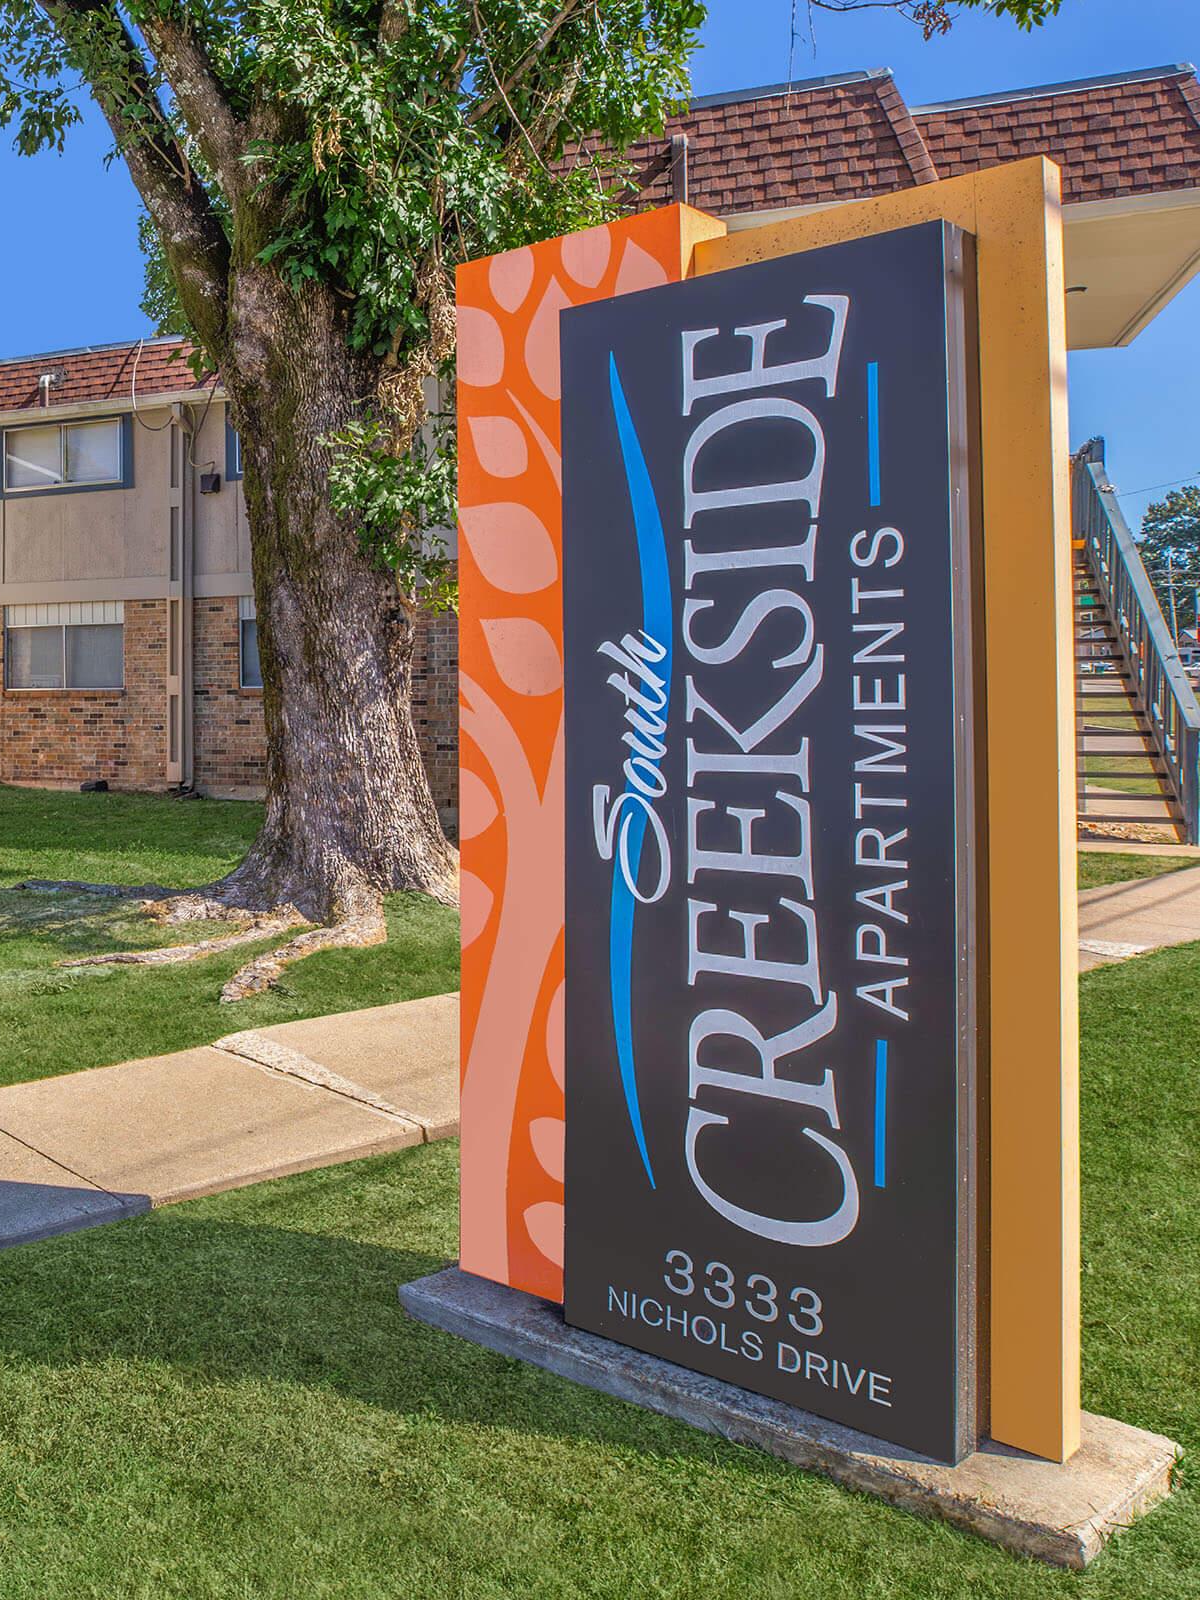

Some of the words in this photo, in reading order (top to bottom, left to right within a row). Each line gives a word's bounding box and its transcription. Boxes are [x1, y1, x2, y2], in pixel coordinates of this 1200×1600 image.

[592, 629, 672, 904] South
[681, 293, 860, 1248] CREEKSIDE
[850, 526, 910, 1023] APARTMENTS
[607, 1286, 765, 1362] NICHOLS
[777, 1341, 893, 1408] DRIVE
[664, 1250, 824, 1337] 3333
